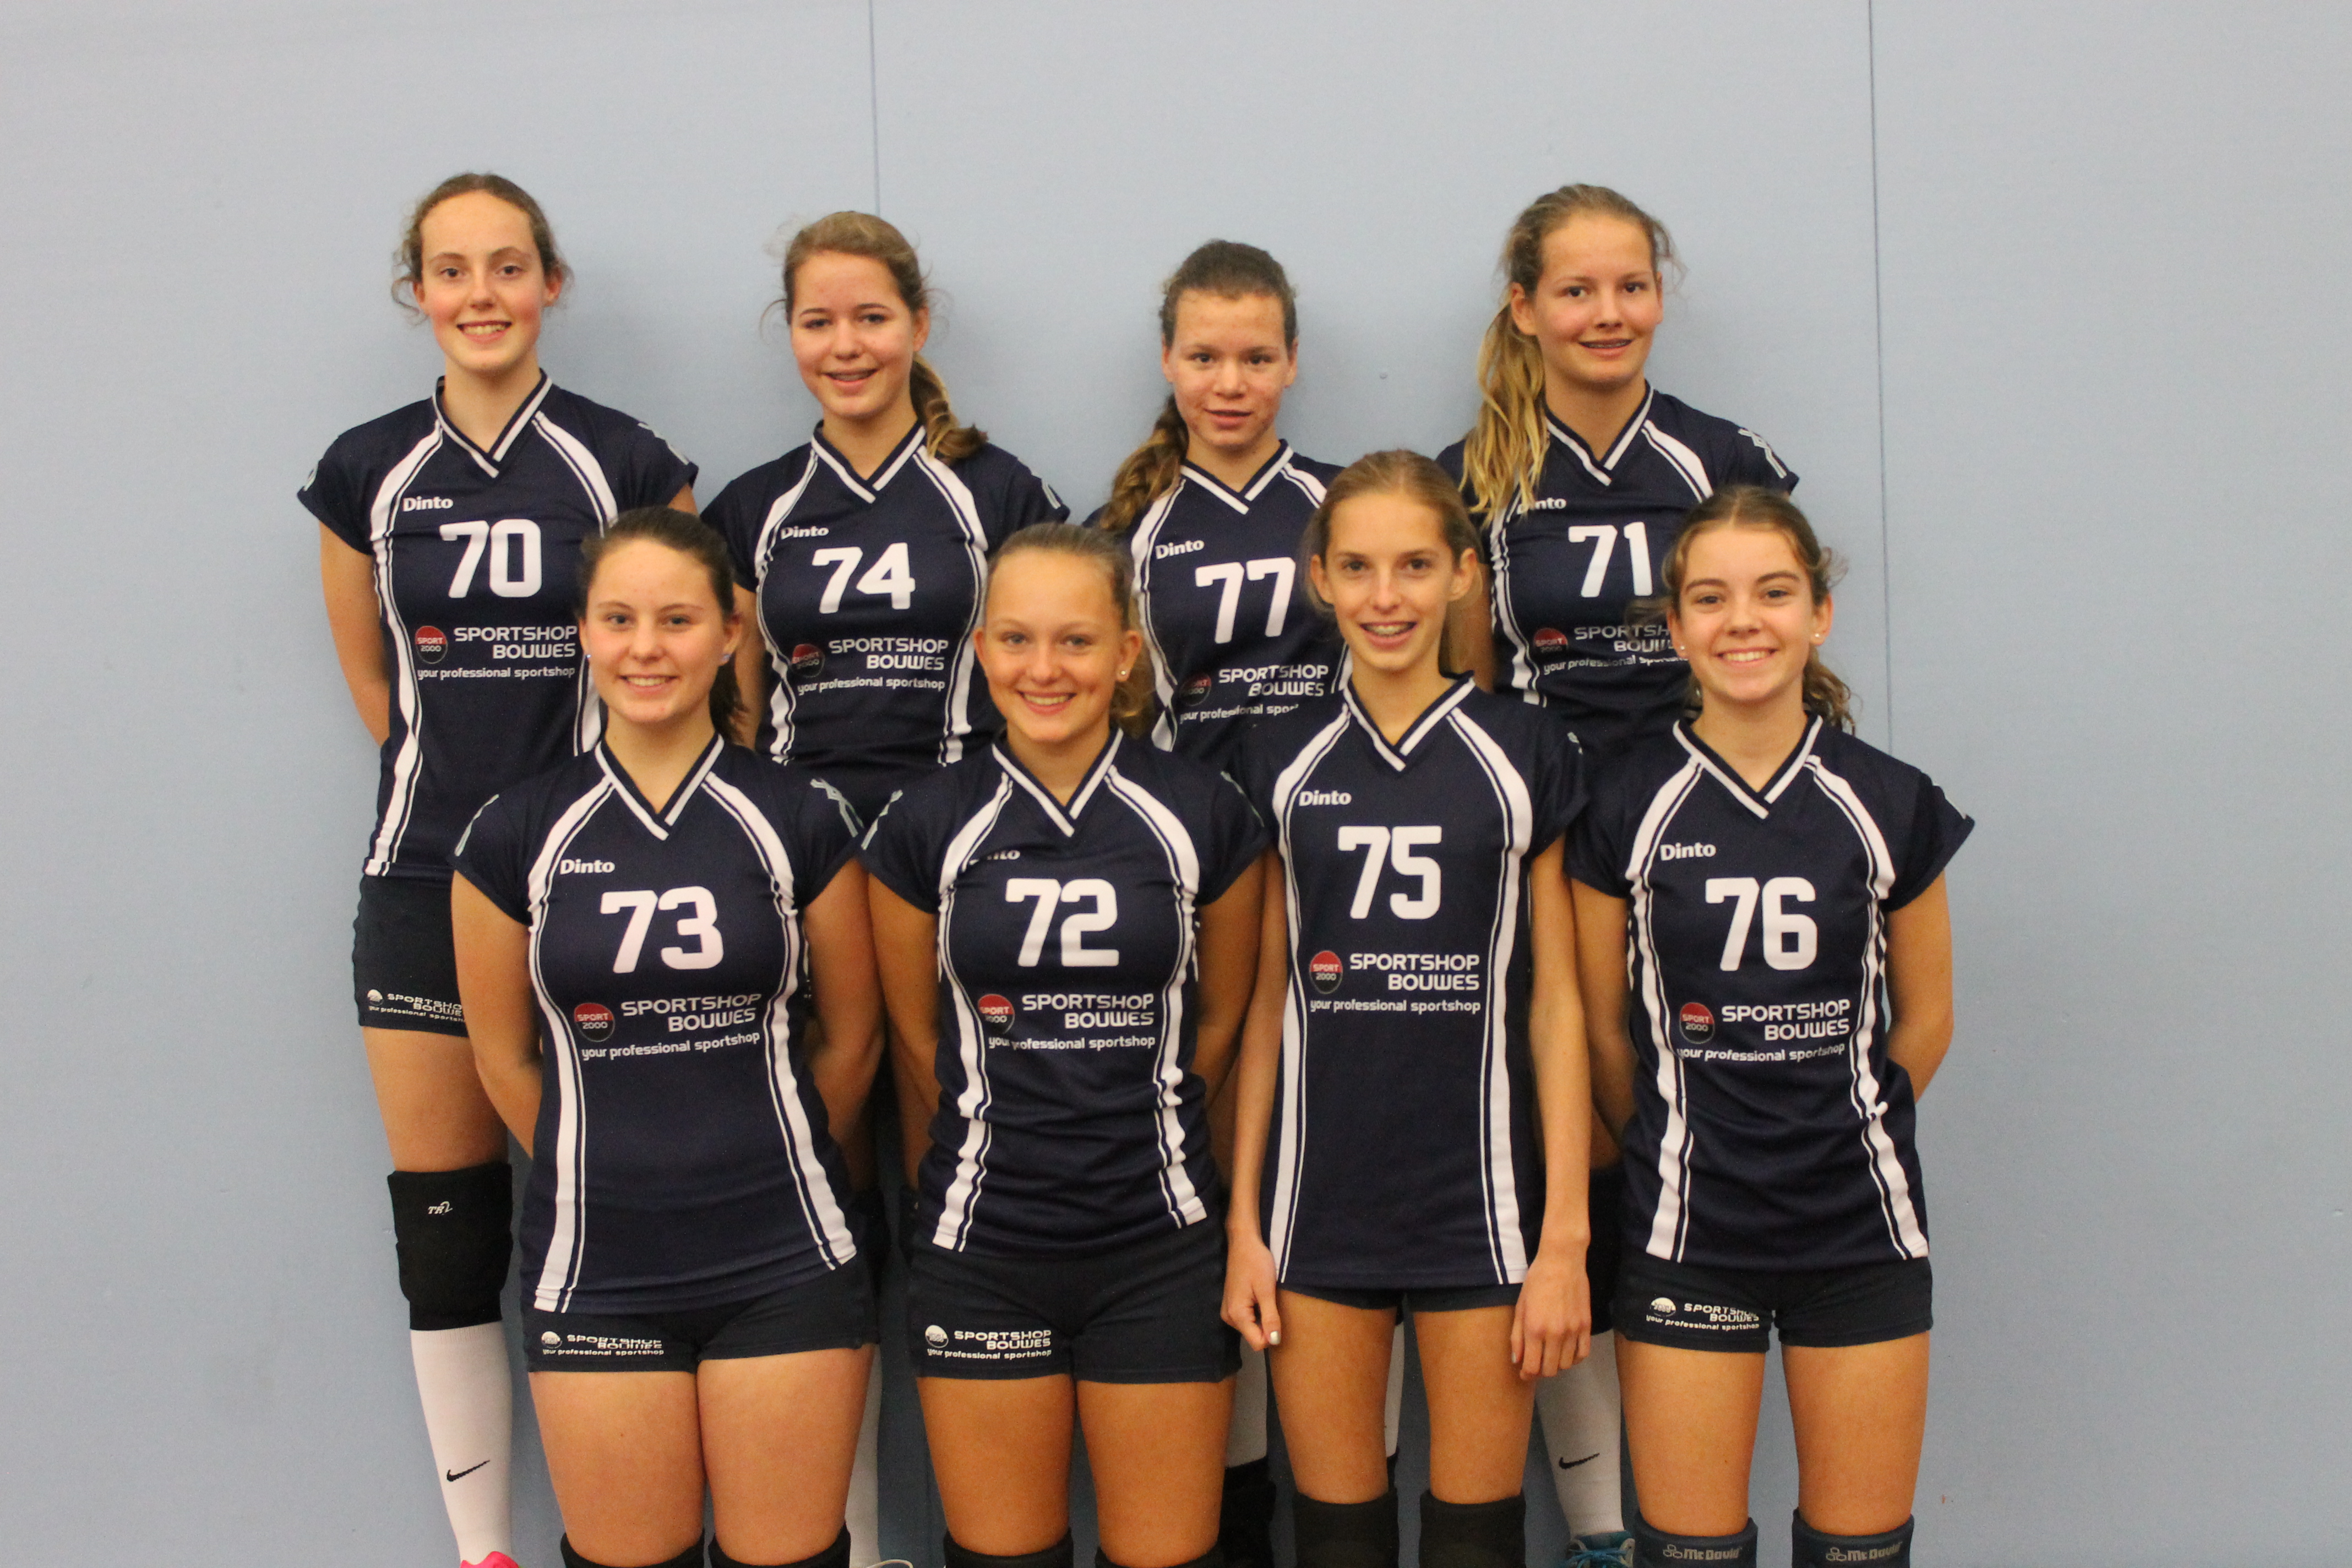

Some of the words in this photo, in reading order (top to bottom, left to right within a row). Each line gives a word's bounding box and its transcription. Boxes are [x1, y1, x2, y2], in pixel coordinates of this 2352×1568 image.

[402, 496, 454, 511] Dinto
[781, 526, 829, 540] Dinto
[1156, 540, 1204, 559] Dinto
[439, 519, 542, 598] 70
[1568, 521, 1653, 598] 71
[812, 542, 916, 614] 74
[1195, 557, 1295, 644] 77
[453, 625, 577, 641] SPORTSHOP
[492, 643, 576, 658] BOUWES
[829, 638, 949, 654] SPORTSHOP
[867, 655, 945, 670] BOUWES
[1544, 661, 1566, 675] your
[417, 669, 438, 680] your
[440, 667, 511, 680] professional
[514, 666, 575, 680] sportshop
[1218, 664, 1329, 683] SPORTSHOP
[797, 683, 818, 696] your
[819, 677, 883, 693] professional
[886, 677, 945, 692] sportshop
[1248, 682, 1324, 696] BOUWES
[1299, 790, 1352, 807] Dinto
[1660, 842, 1716, 861] Dinto
[560, 859, 615, 874] Dinto
[1338, 825, 1442, 919] 75
[600, 886, 724, 973] 73
[1005, 878, 1119, 967] 72
[1705, 876, 1817, 971] 76
[1313, 963, 1340, 972] SPORT
[1349, 953, 1480, 971] SPORTSHOP
[1315, 972, 1337, 981] 2000
[1387, 973, 1480, 990] BOUWES
[387, 993, 462, 1010] SPORTSHO
[413, 1003, 462, 1016] BOUWE
[620, 994, 761, 1016] SPORTSHOP
[1022, 993, 1155, 1011] SPORTSHOP
[1310, 999, 1332, 1012] your
[1333, 999, 1407, 1013] professional
[1410, 999, 1481, 1015] sportshop
[577, 1012, 609, 1021] SPORT
[1681, 1014, 1709, 1023] SPORT
[1722, 999, 1851, 1022] SPORTSHOP
[668, 1008, 756, 1032] BOUWES
[1065, 1012, 1155, 1029] BOUWES
[1685, 1023, 1708, 1032] 2000
[1765, 1019, 1850, 1041] BOUWES
[581, 1048, 607, 1061] your
[609, 1040, 691, 1060] professional
[694, 1032, 760, 1053] sportshop
[1088, 1035, 1155, 1052] sportshop
[1677, 1048, 1703, 1060] your
[1705, 1048, 1785, 1061] professional
[1789, 1043, 1845, 1062] sportshop
[1665, 1319, 1719, 1330] professional
[1722, 1324, 1760, 1332] sportshop
[954, 1330, 1052, 1341] SPORTSHOP
[986, 1338, 1051, 1350] BOUWES
[944, 1351, 1000, 1359] professional
[1004, 1349, 1052, 1360] sportshop
